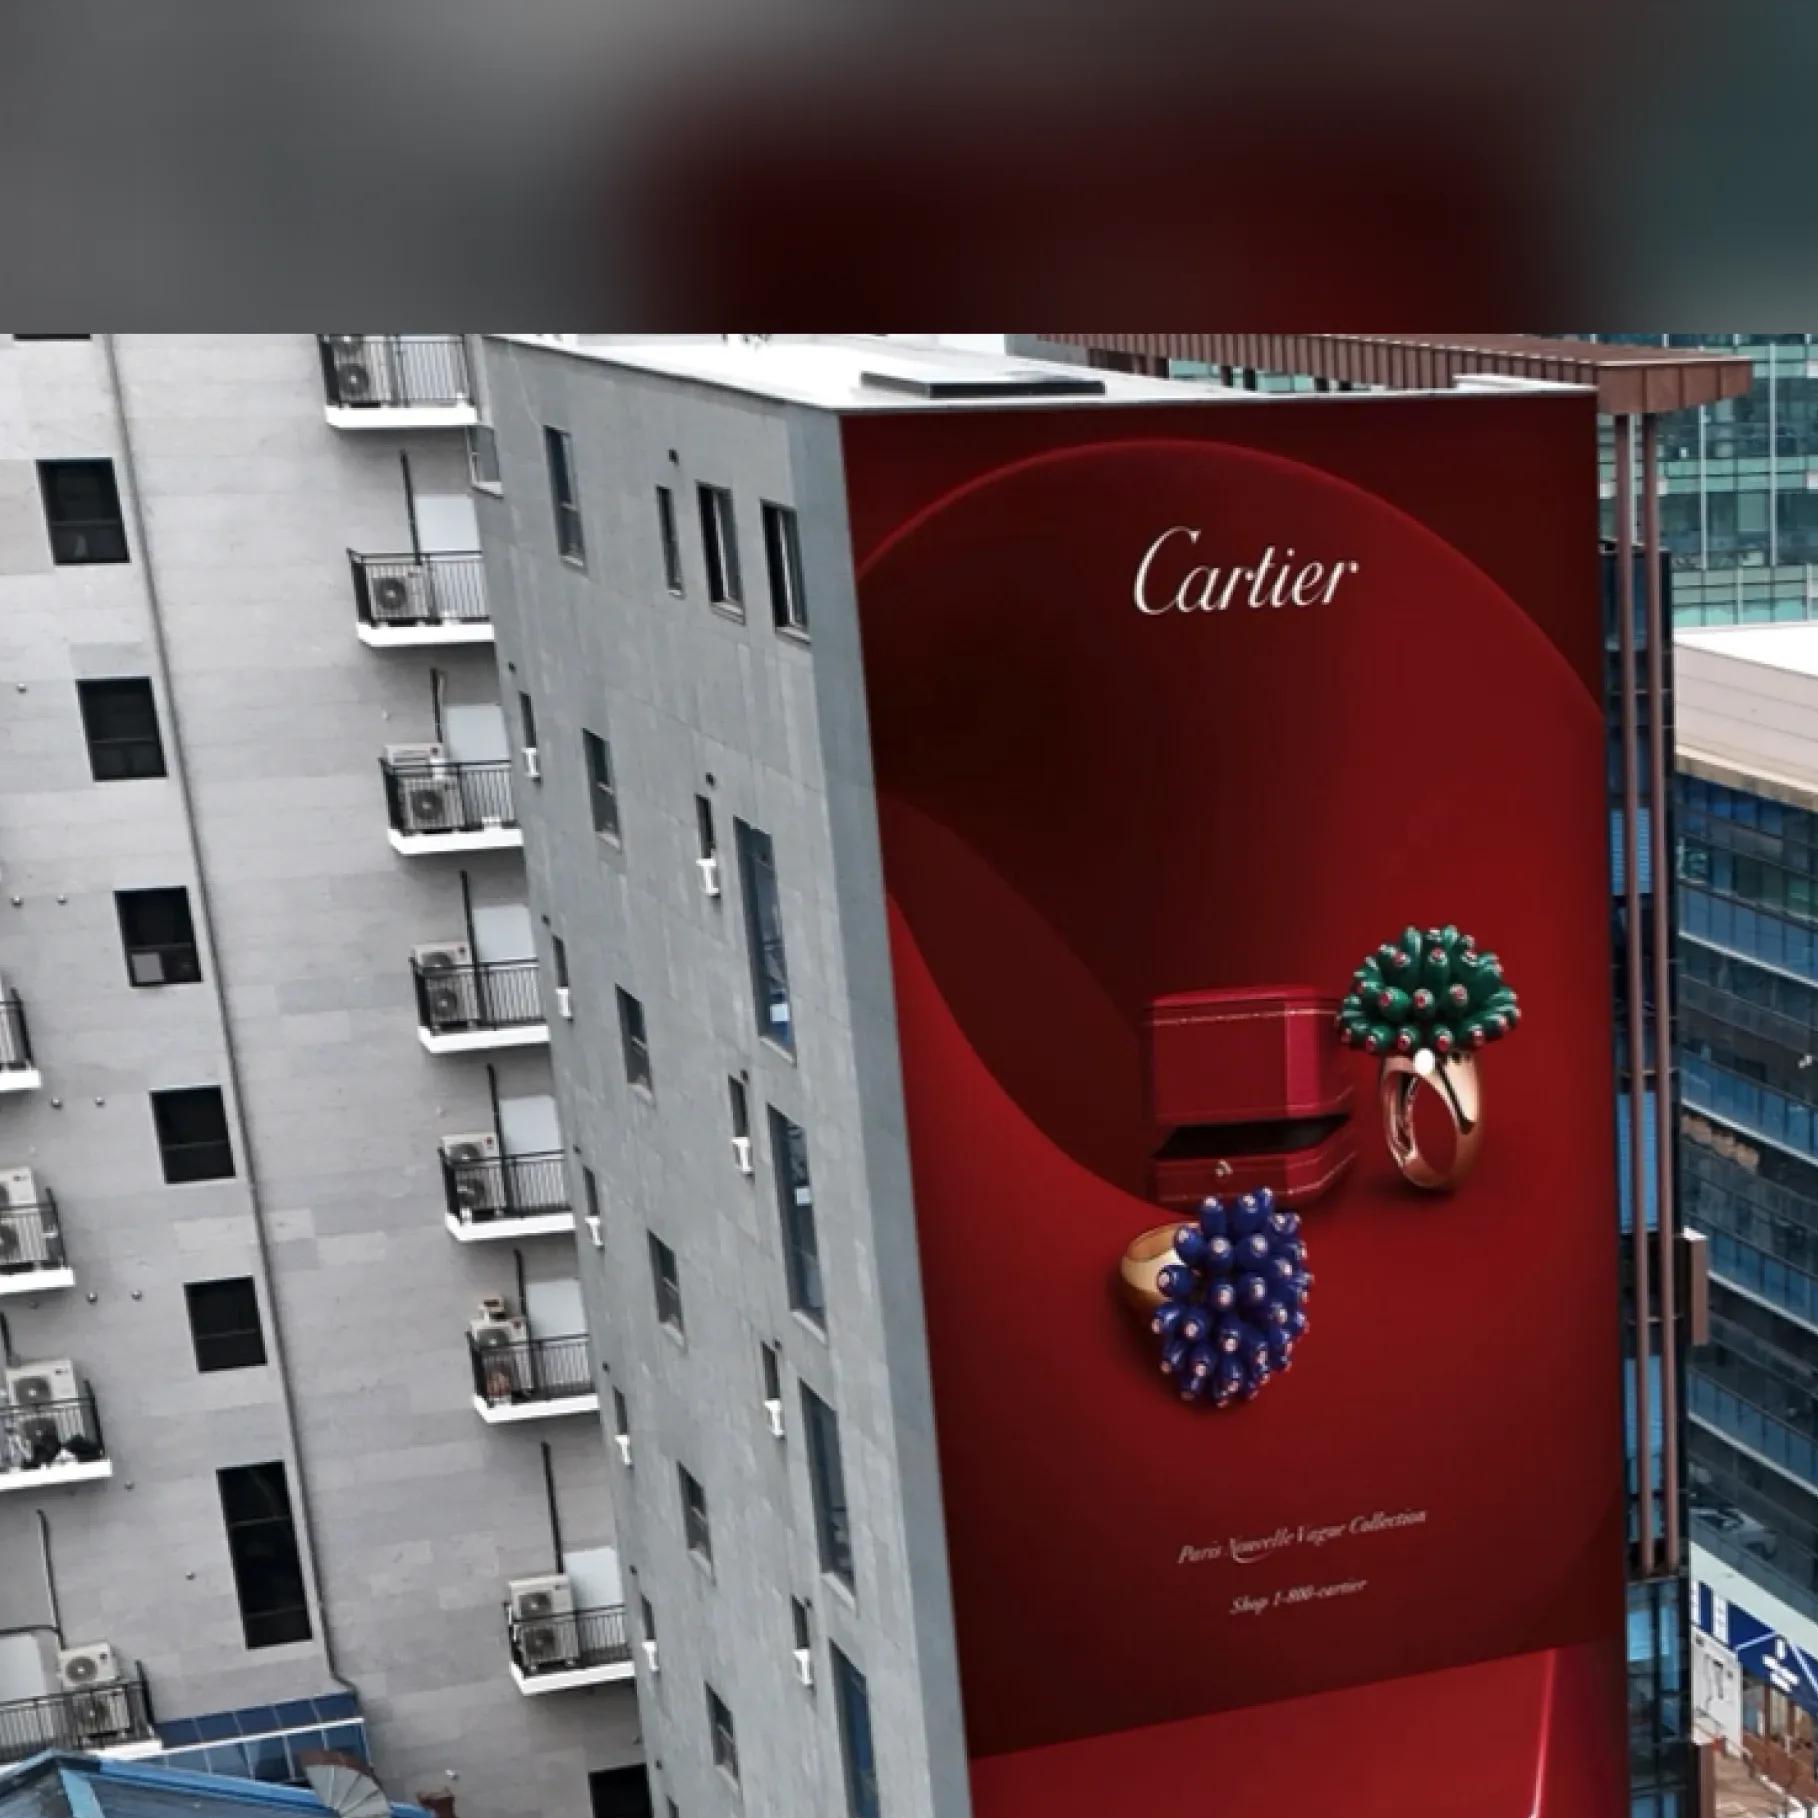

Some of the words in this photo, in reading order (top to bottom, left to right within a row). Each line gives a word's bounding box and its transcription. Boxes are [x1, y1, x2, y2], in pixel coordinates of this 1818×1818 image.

[1131, 526, 1360, 616] Cartier
[1348, 1507, 1427, 1535] Collection
[1229, 1593, 1269, 1616] Shop
